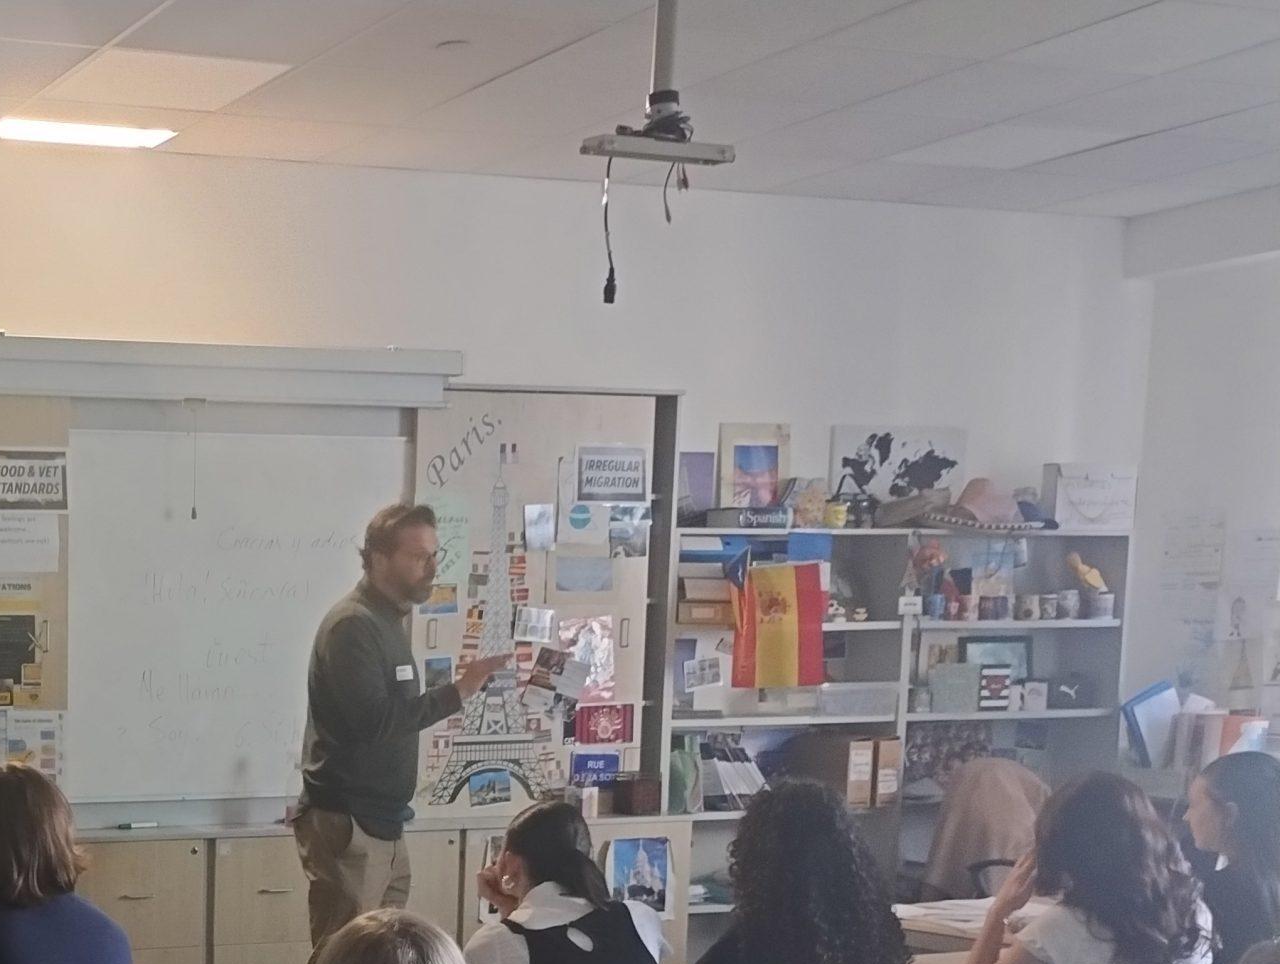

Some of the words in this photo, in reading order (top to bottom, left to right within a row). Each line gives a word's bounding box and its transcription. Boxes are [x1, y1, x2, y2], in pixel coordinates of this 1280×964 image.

[426, 413, 502, 488] Paris.
[27, 464, 36, 478] &
[38, 464, 60, 478] VET
[584, 459, 640, 472] IRREGULAR
[584, 476, 640, 488] MIGRATION
[746, 509, 787, 526] Spanish
[587, 760, 605, 769] RUE
